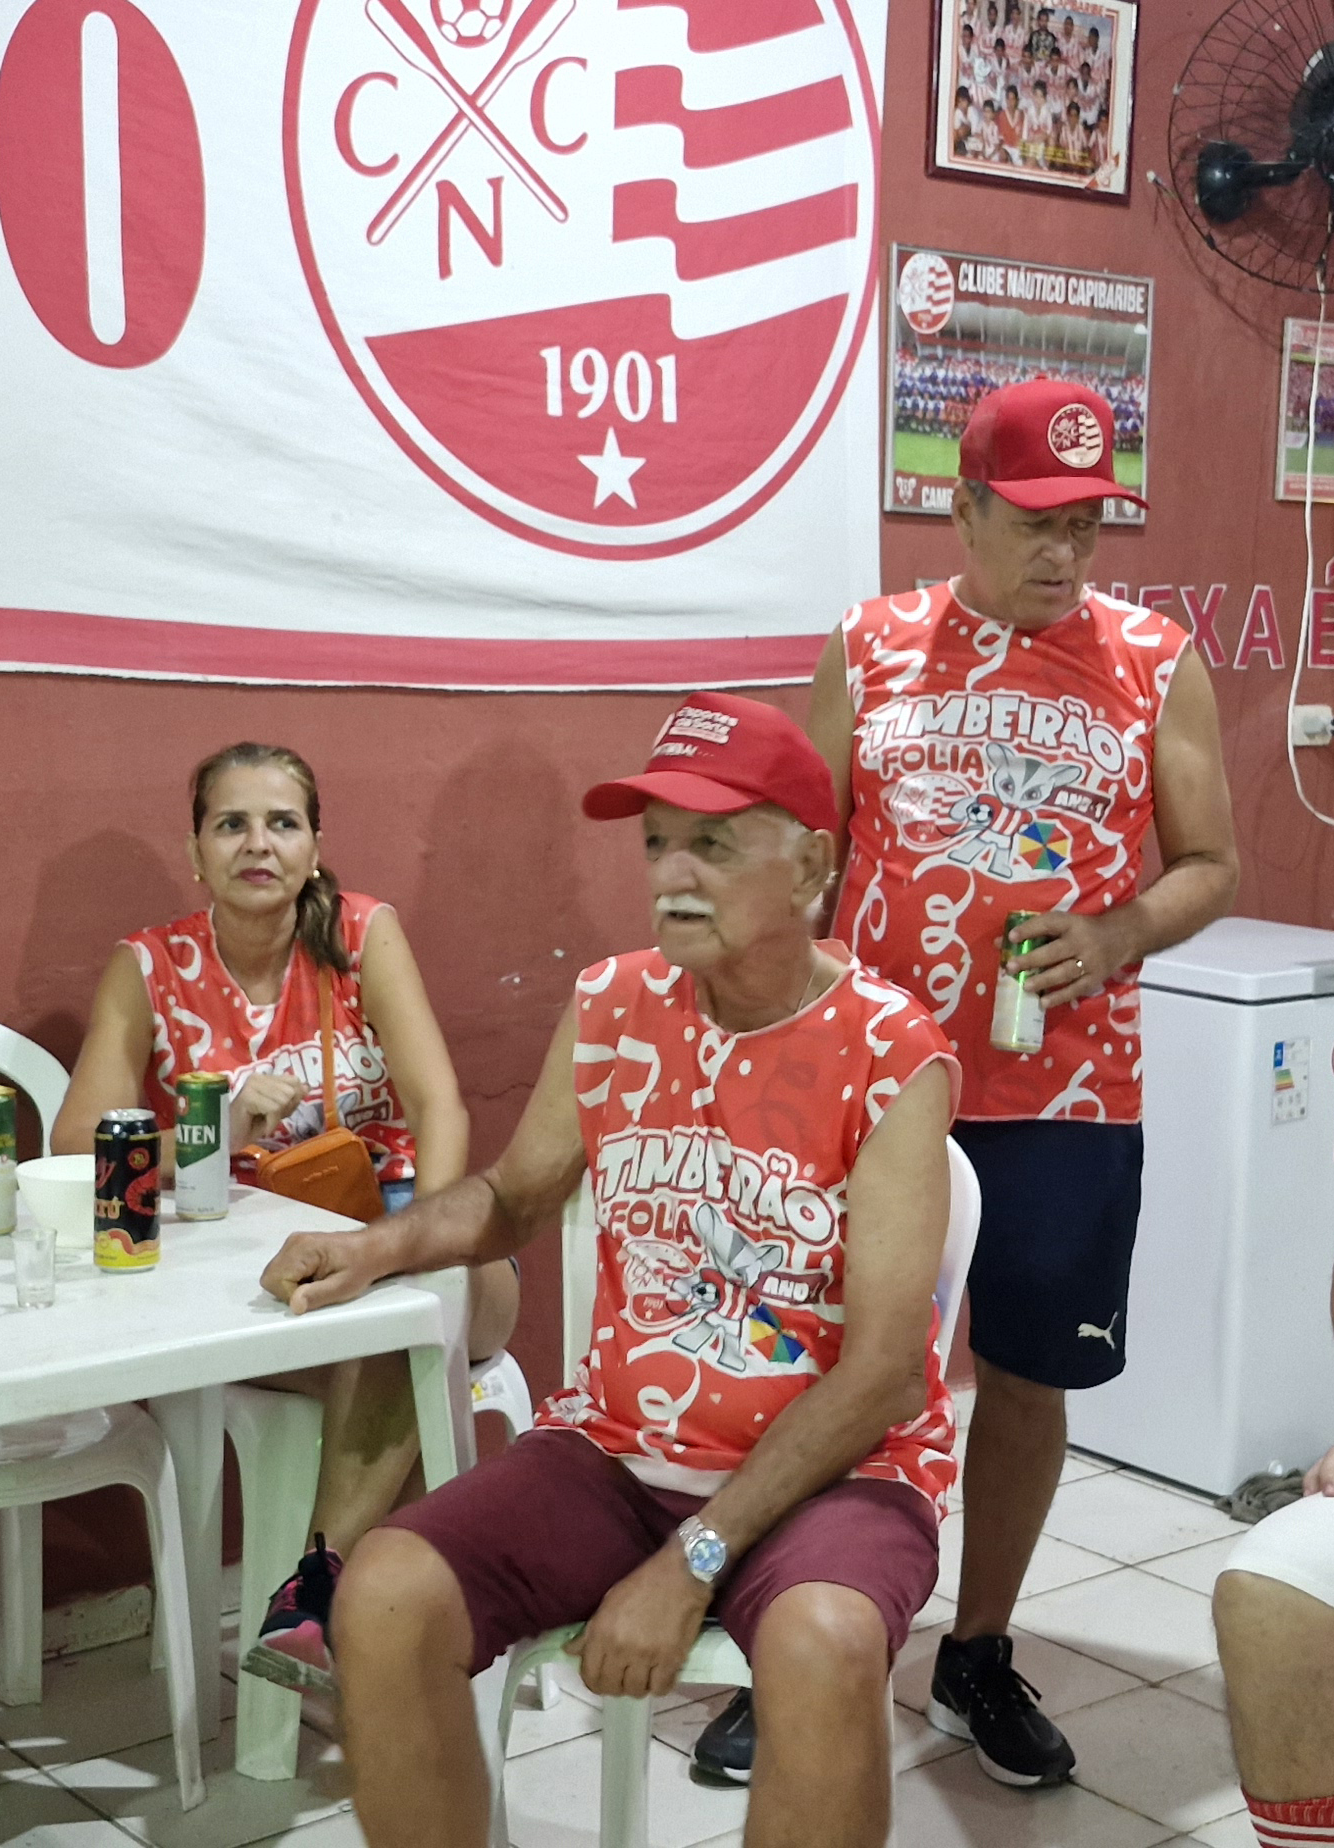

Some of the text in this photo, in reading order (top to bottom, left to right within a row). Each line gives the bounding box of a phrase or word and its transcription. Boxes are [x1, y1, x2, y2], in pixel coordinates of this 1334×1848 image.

[958, 261, 1146, 314] CLUBE NÁUTICO CAPIBARIBE
[540, 345, 677, 423] 1901
[869, 694, 1124, 776] TIMBEIRÃO
[881, 742, 984, 779] FOLIA
